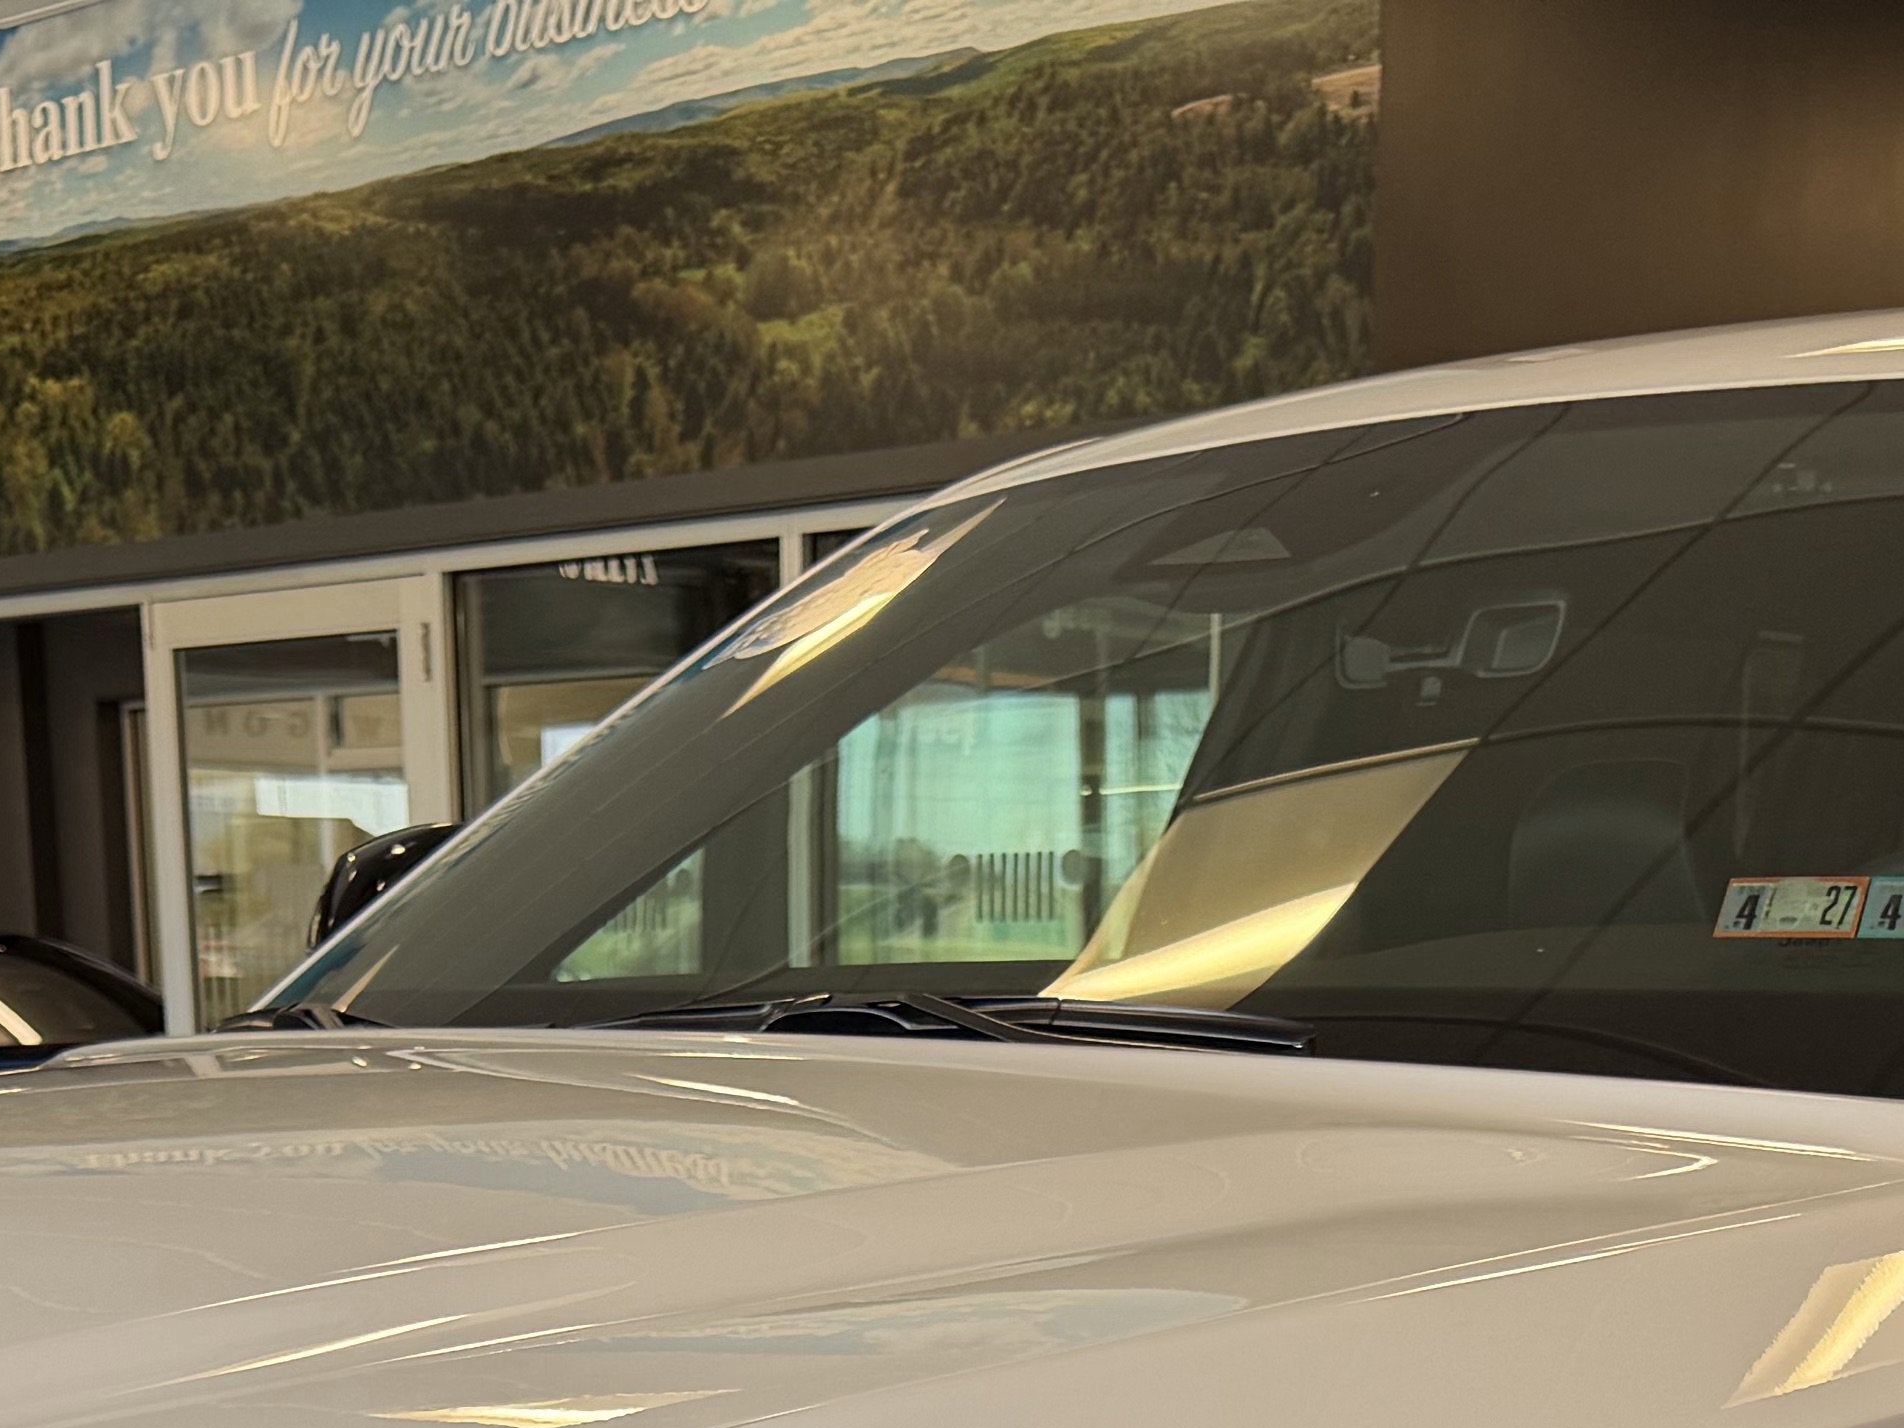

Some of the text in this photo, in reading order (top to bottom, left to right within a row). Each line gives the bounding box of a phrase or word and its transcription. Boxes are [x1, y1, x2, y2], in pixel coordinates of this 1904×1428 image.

[151, 50, 262, 161] you
[267, 17, 346, 148] for
[347, 9, 476, 138] your
[485, 0, 709, 57] busine
[1734, 894, 1760, 930] 4
[1819, 885, 1858, 928] 27
[1880, 894, 1903, 930] 4
